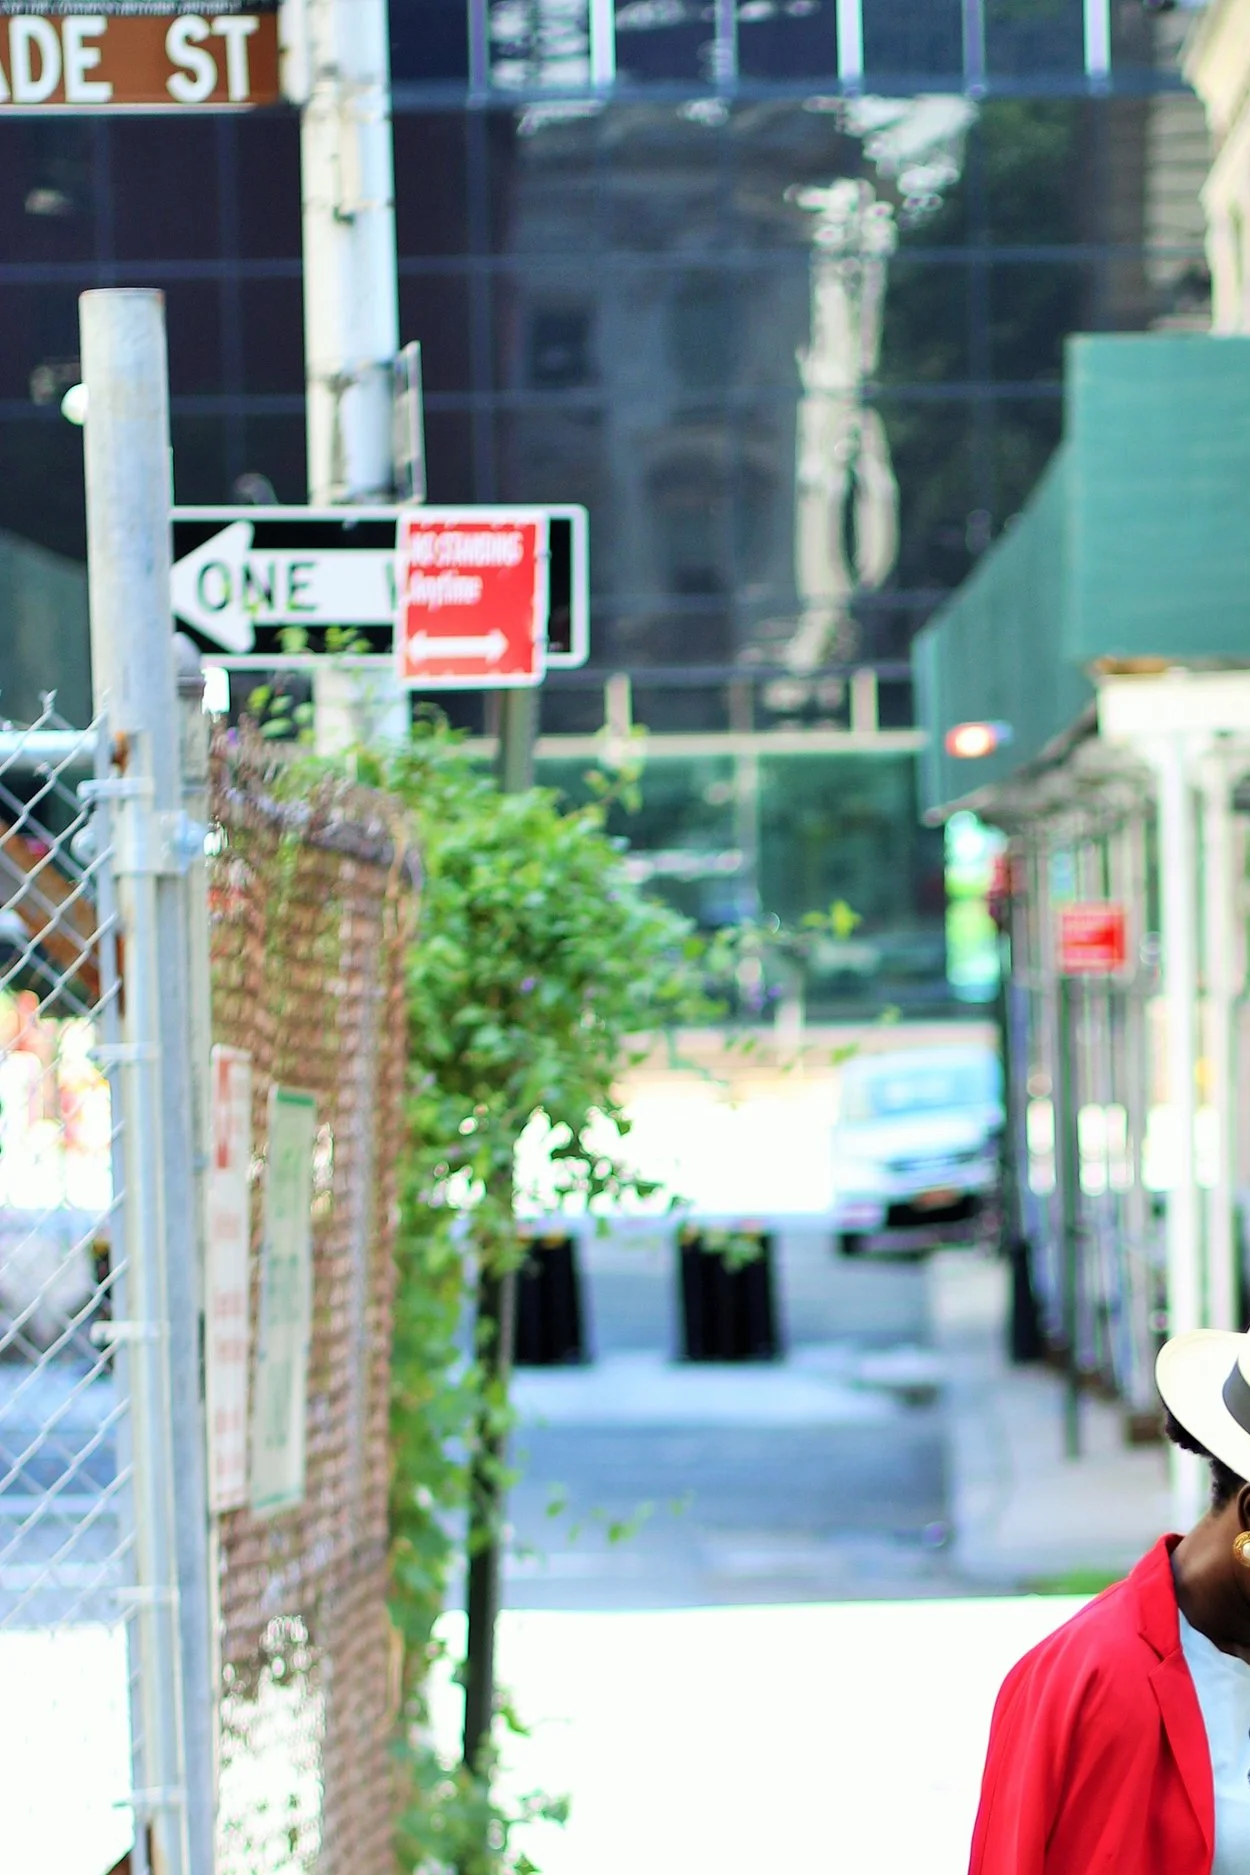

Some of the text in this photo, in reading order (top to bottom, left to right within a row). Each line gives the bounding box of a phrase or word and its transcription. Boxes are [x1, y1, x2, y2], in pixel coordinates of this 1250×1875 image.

[0, 14, 260, 103] DE ST
[434, 531, 524, 567] STANDING
[196, 560, 318, 613] ONE
